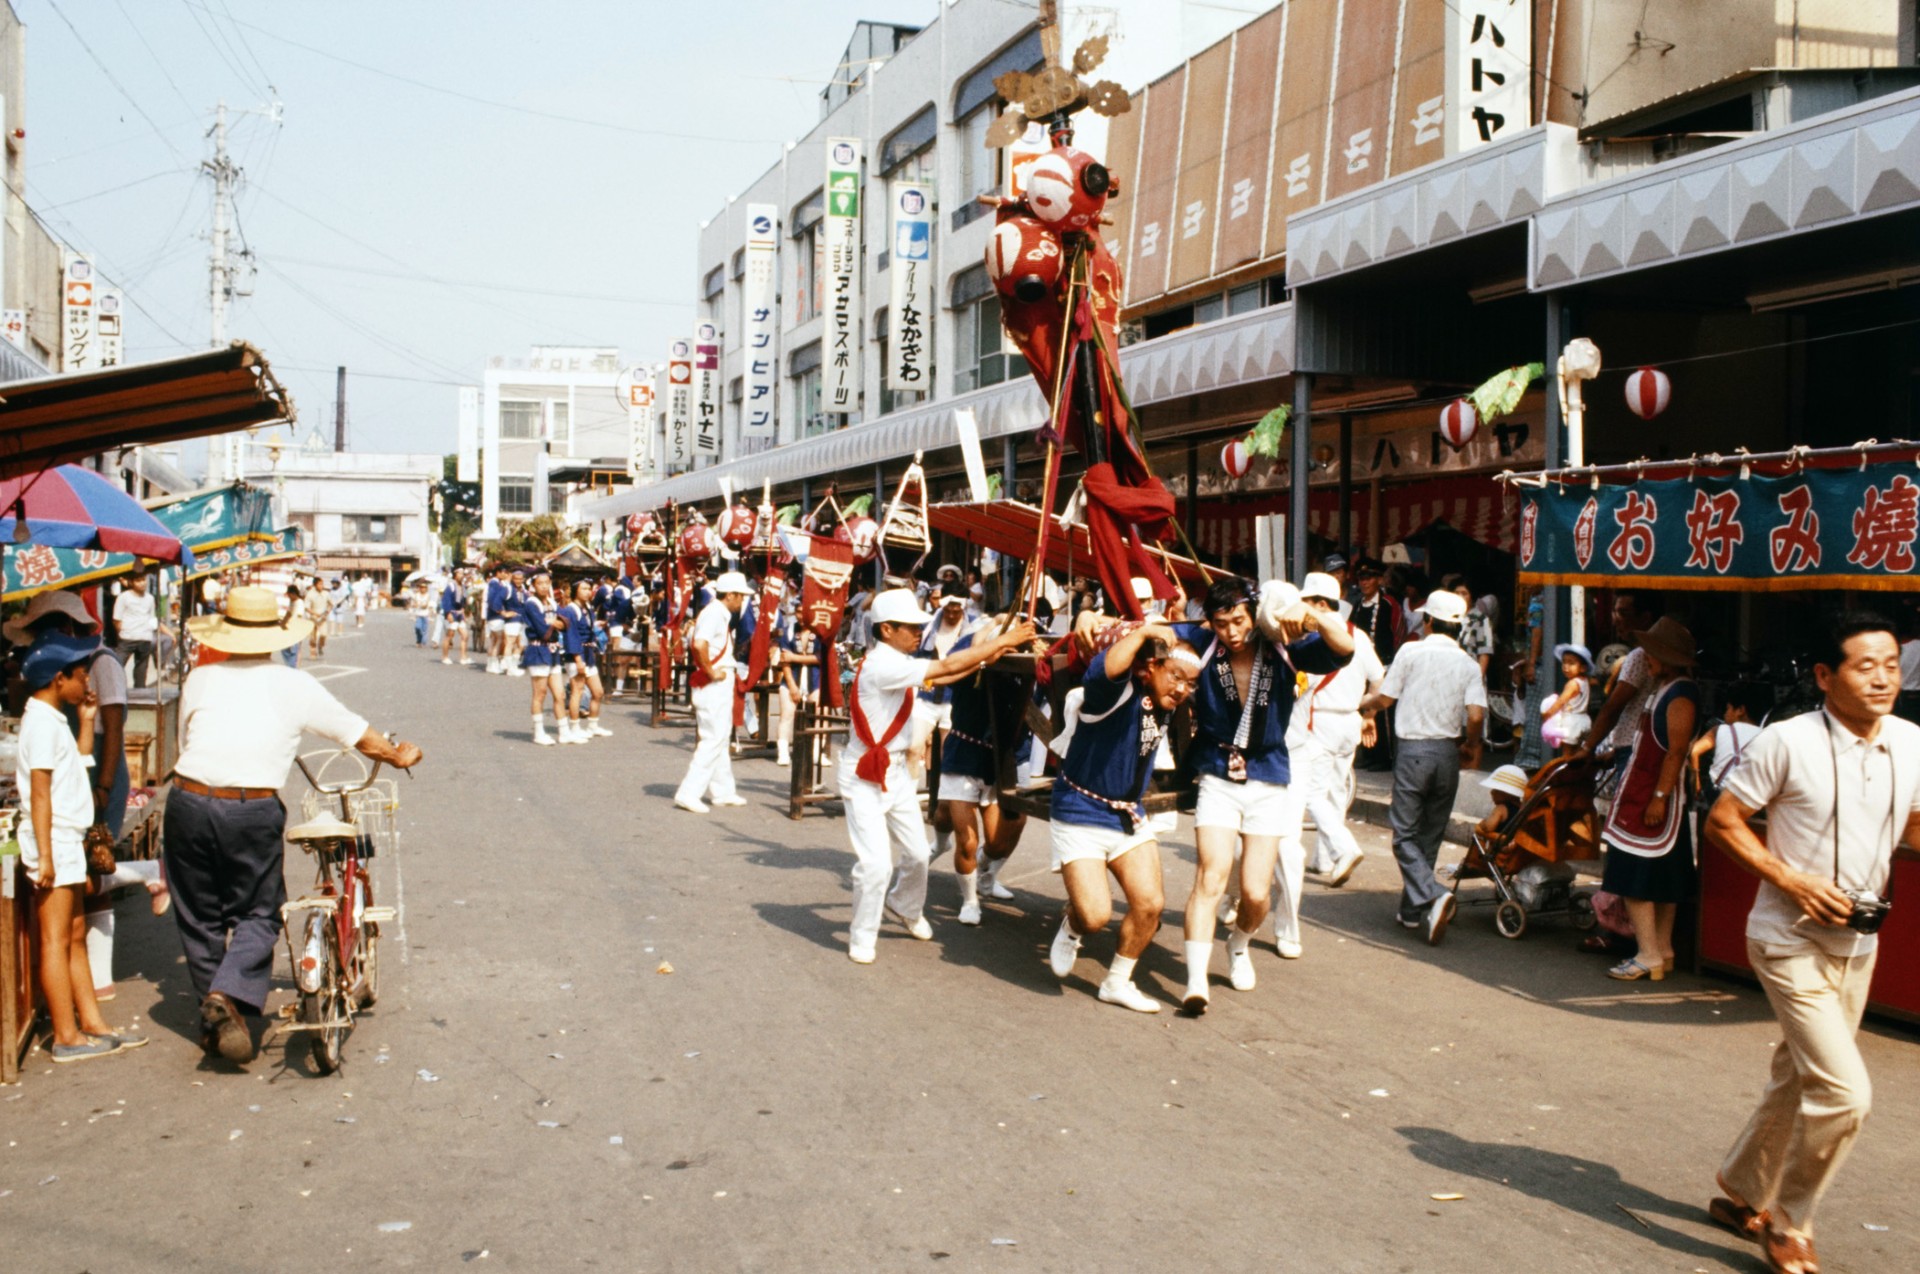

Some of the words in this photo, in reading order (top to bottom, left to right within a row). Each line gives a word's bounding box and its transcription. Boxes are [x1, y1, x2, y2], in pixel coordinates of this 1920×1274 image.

[1471, 14, 1505, 141] ハトヤ
[900, 303, 922, 382] なかざわ
[673, 418, 687, 460] かとう
[698, 401, 715, 450] ヤナミ
